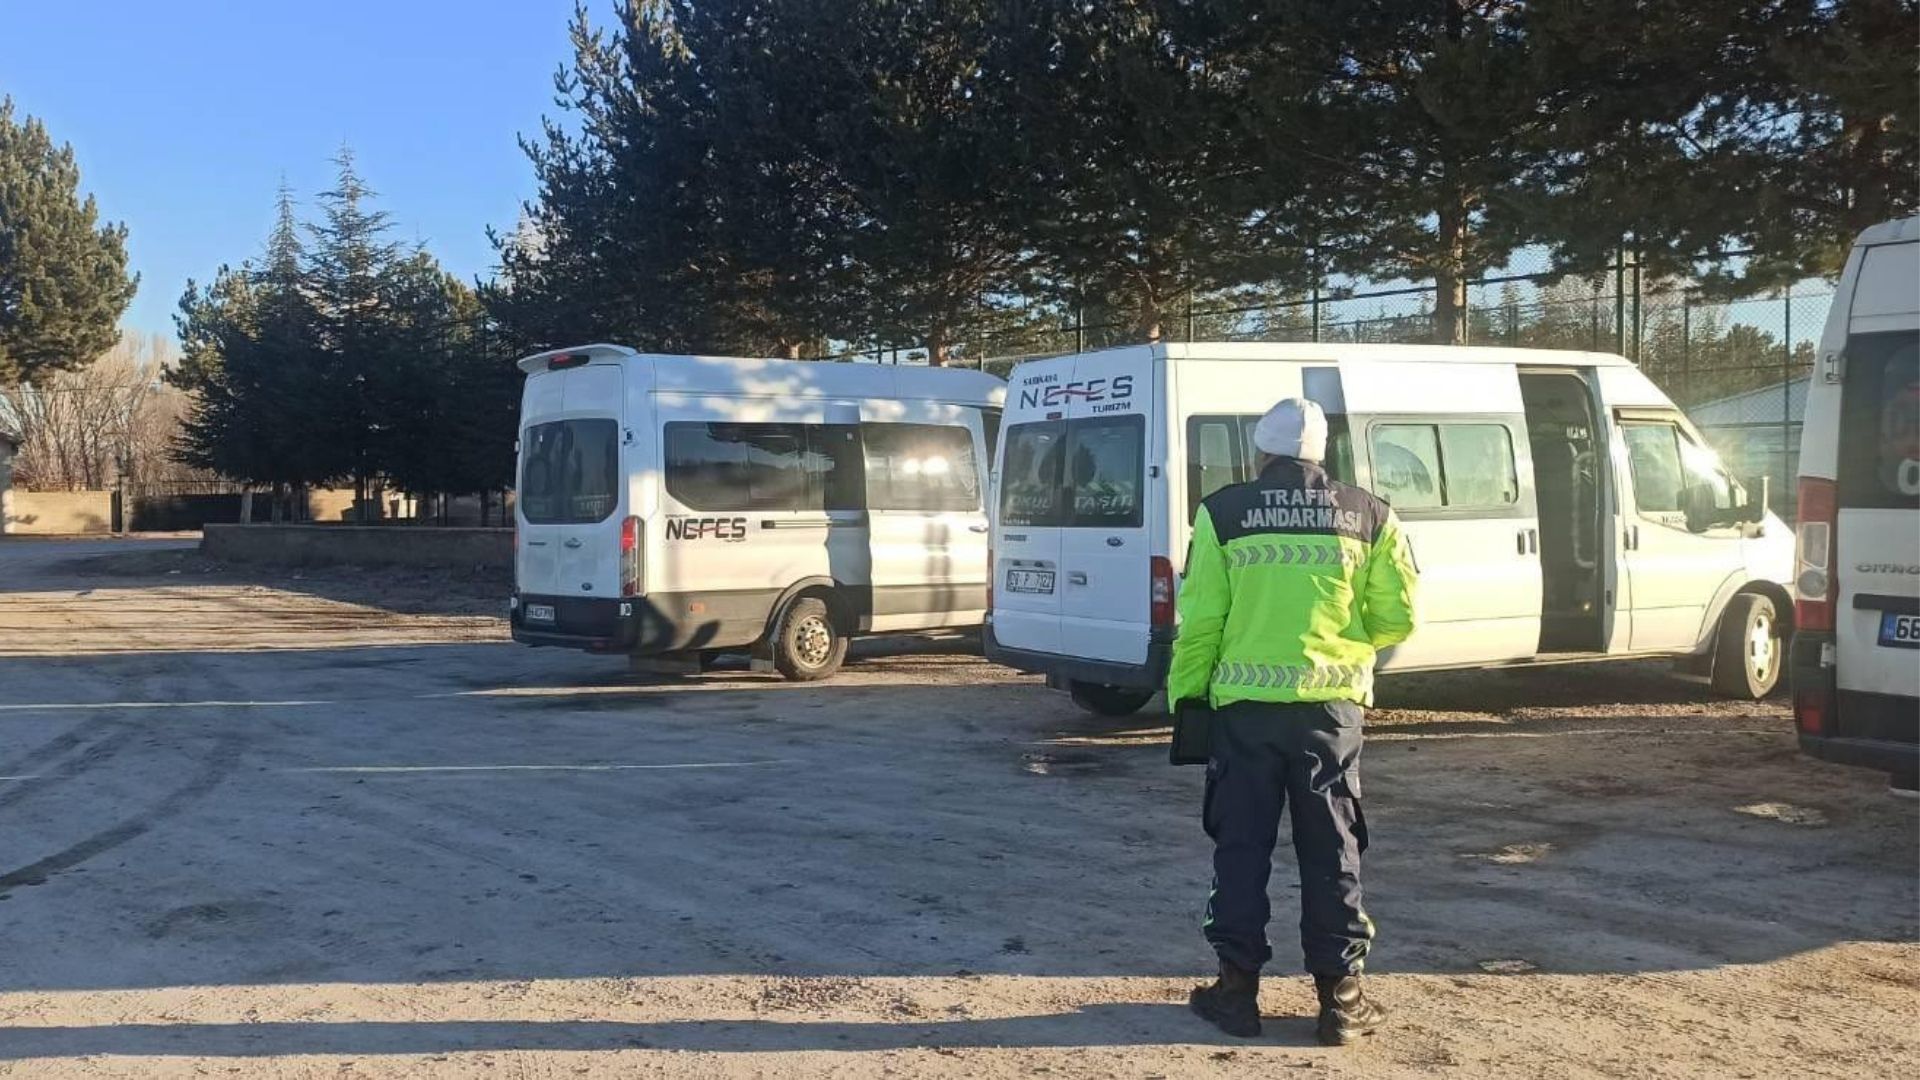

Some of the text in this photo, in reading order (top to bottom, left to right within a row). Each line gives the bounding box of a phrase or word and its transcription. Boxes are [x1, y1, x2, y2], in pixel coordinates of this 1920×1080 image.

[1020, 375, 1133, 409] NEFES
[666, 517, 747, 540] NEFES
[1241, 508, 1362, 533] JANDARMASI
[1896, 617, 1920, 640] 66
